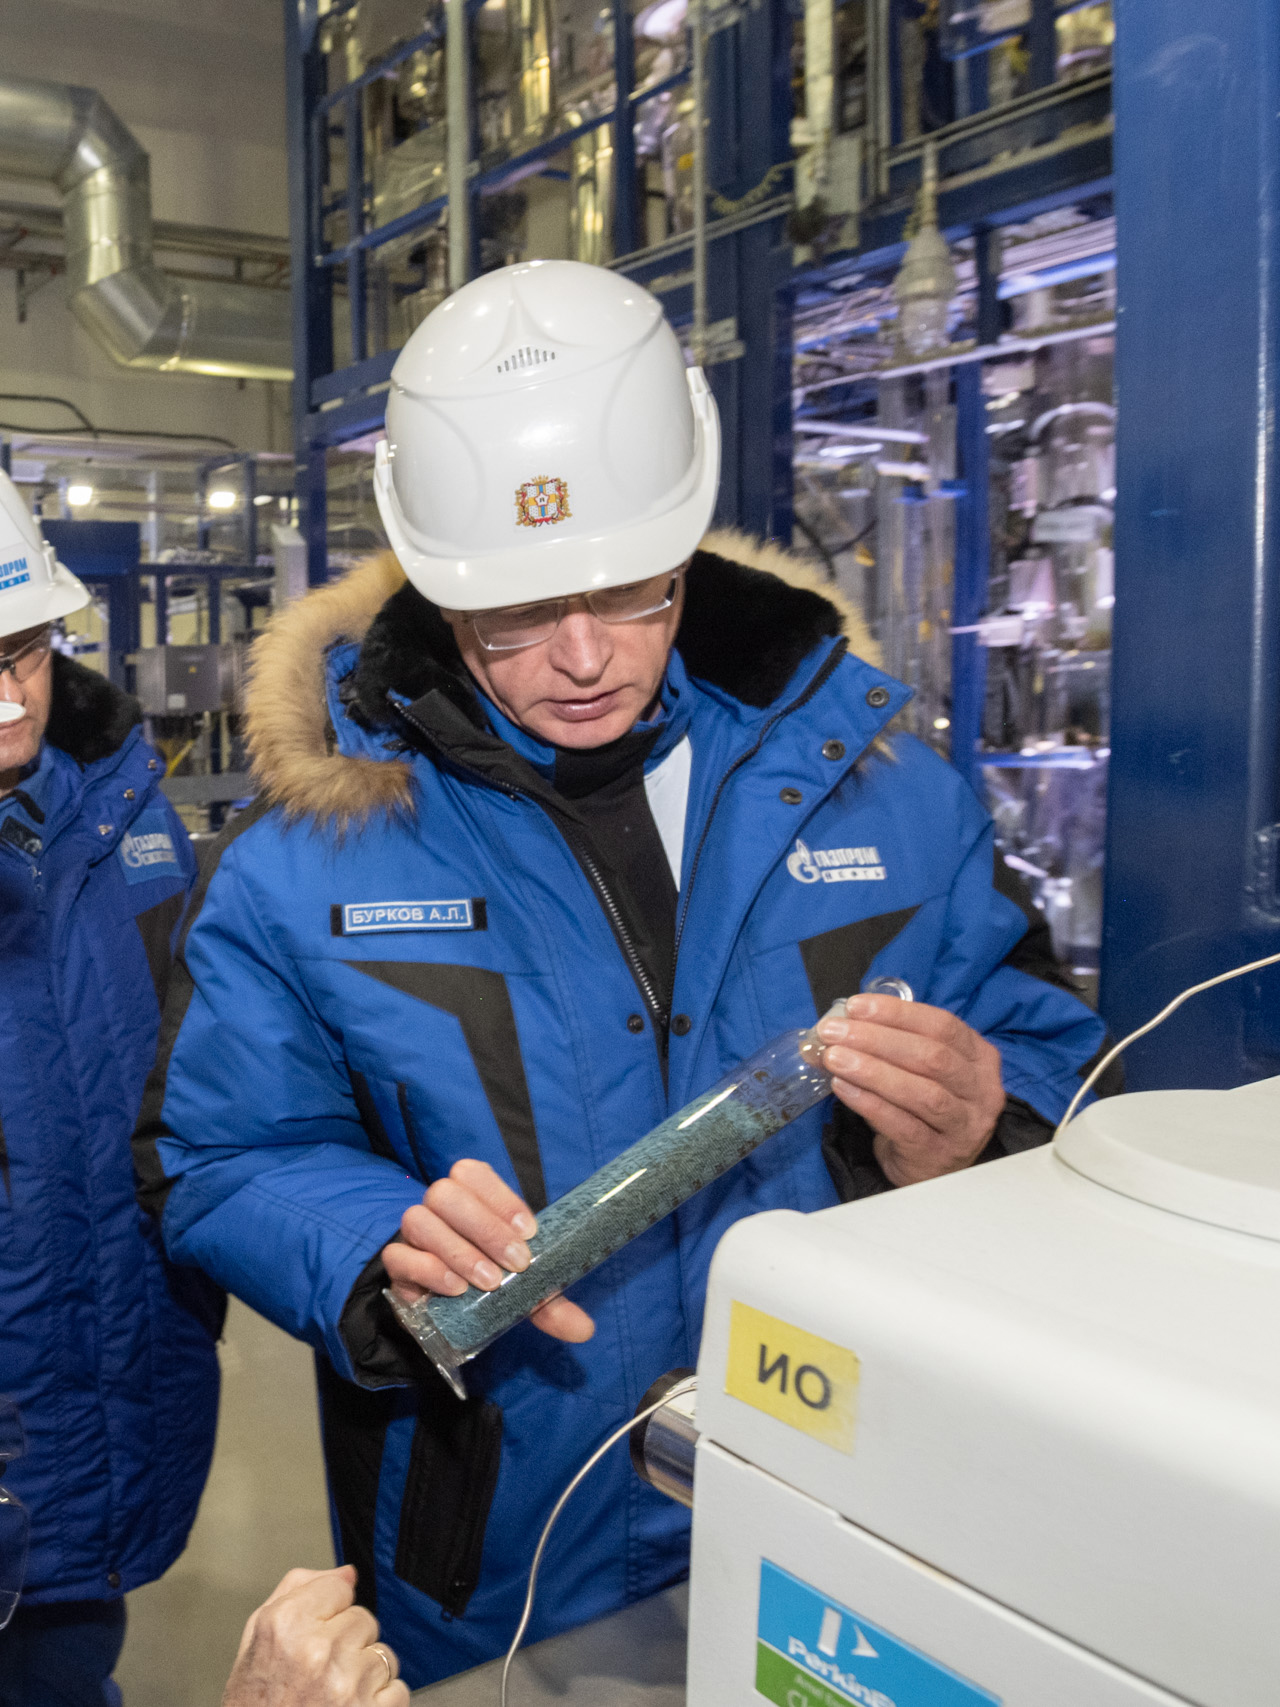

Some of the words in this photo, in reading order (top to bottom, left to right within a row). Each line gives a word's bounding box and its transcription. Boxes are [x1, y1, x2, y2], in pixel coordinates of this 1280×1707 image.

[812, 847, 881, 867] ГАЗПРОМ
[823, 868, 883, 882] НЕФТЬ
[352, 908, 424, 924] БУРКОВ
[429, 907, 464, 921] А.Л.
